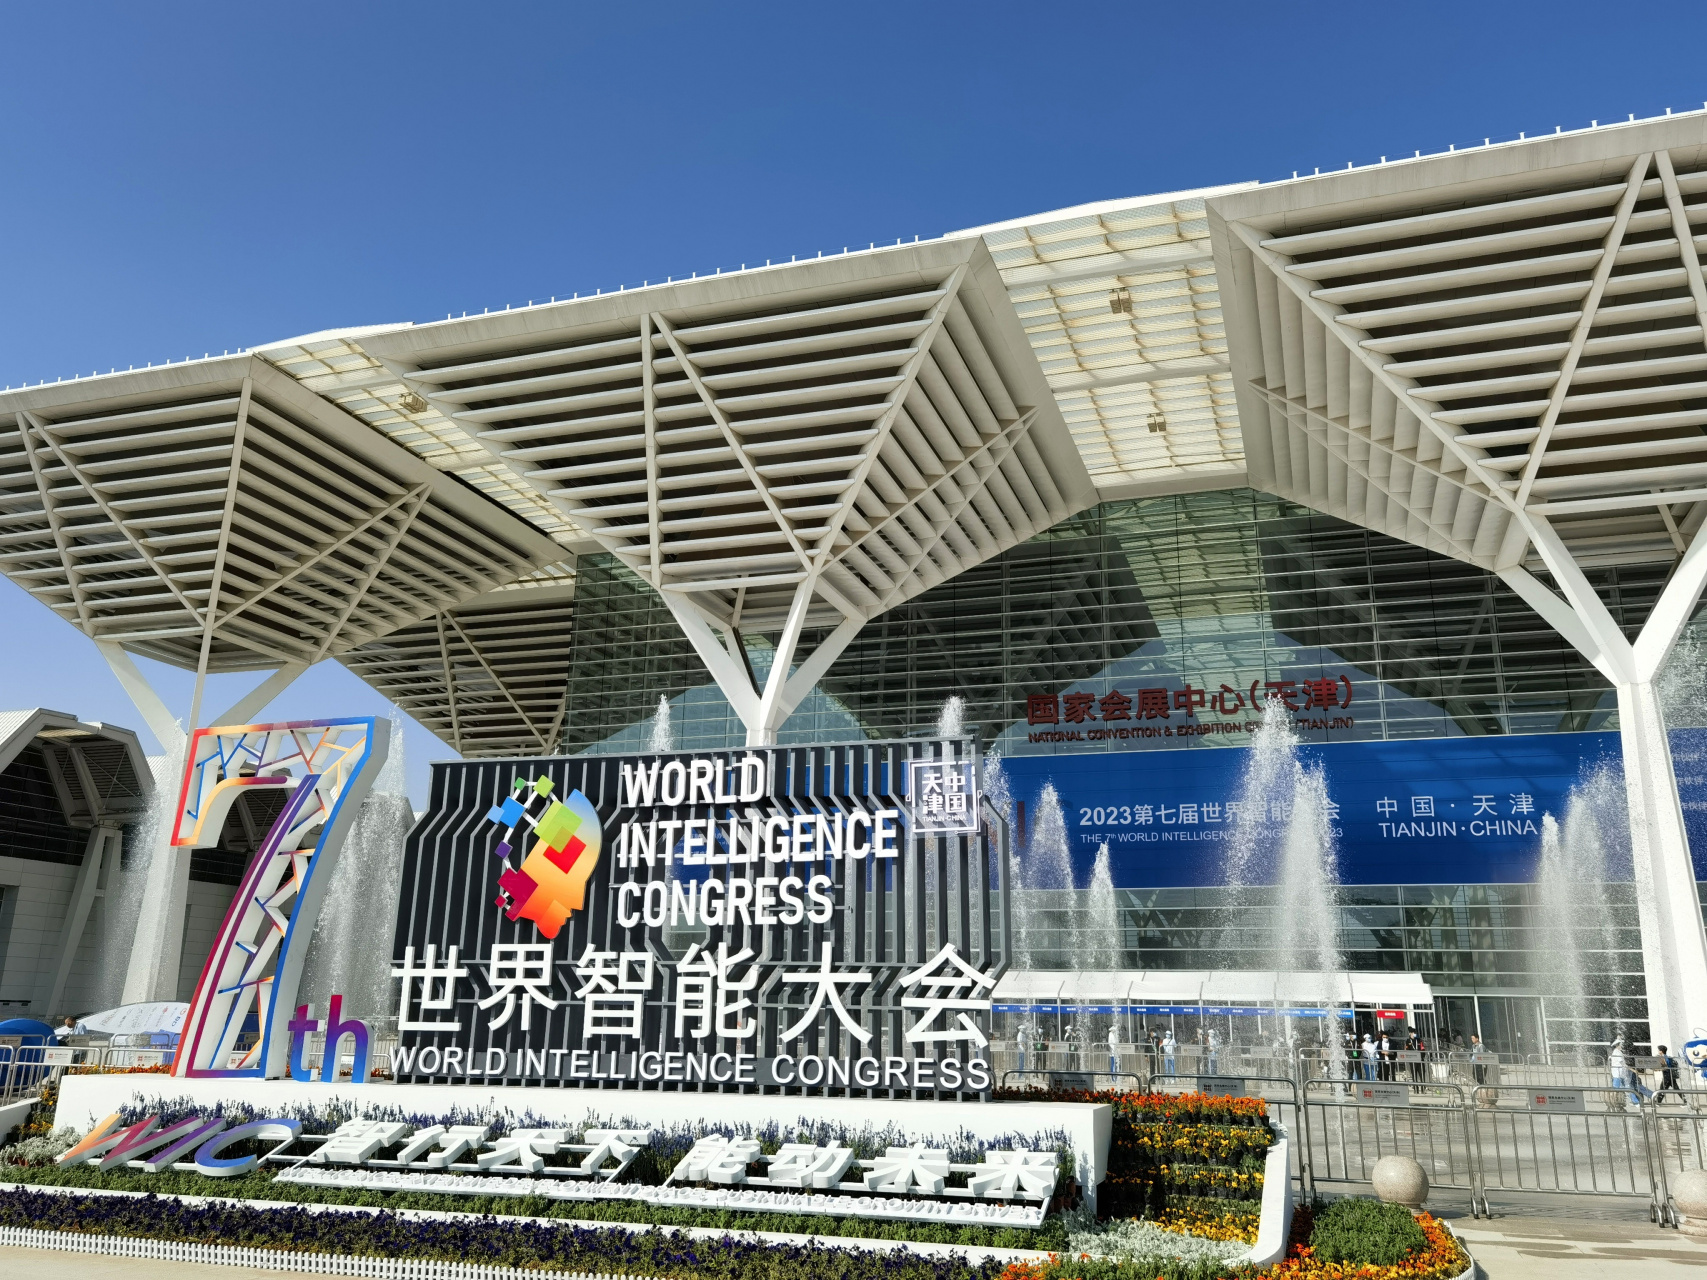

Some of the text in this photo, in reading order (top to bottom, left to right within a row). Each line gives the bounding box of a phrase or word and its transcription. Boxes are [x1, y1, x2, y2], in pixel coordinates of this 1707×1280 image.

[1028, 728, 1084, 743] NATIONAL
[1087, 725, 1162, 742] CONVENTION
[1164, 724, 1174, 737] &
[1177, 721, 1242, 737] EXHIBITION
[621, 756, 769, 808] WORLD
[921, 773, 943, 815] 天津
[944, 771, 966, 814] 中国
[1079, 798, 1340, 826] 2023第七届世界智能会
[618, 809, 899, 868] INTELLIGENCE
[1081, 833, 1103, 843] THE
[1105, 833, 1117, 843] 7th
[1118, 832, 1159, 843] WORLD
[616, 874, 834, 929] CONGRESS
[390, 941, 995, 1049] 世界智能大会
[389, 1046, 991, 1092] WORLD INTELLIGENCE CONGRESS
[60, 1113, 302, 1177] WIC
[314, 1116, 1059, 1199] 智行天下 能动未来
